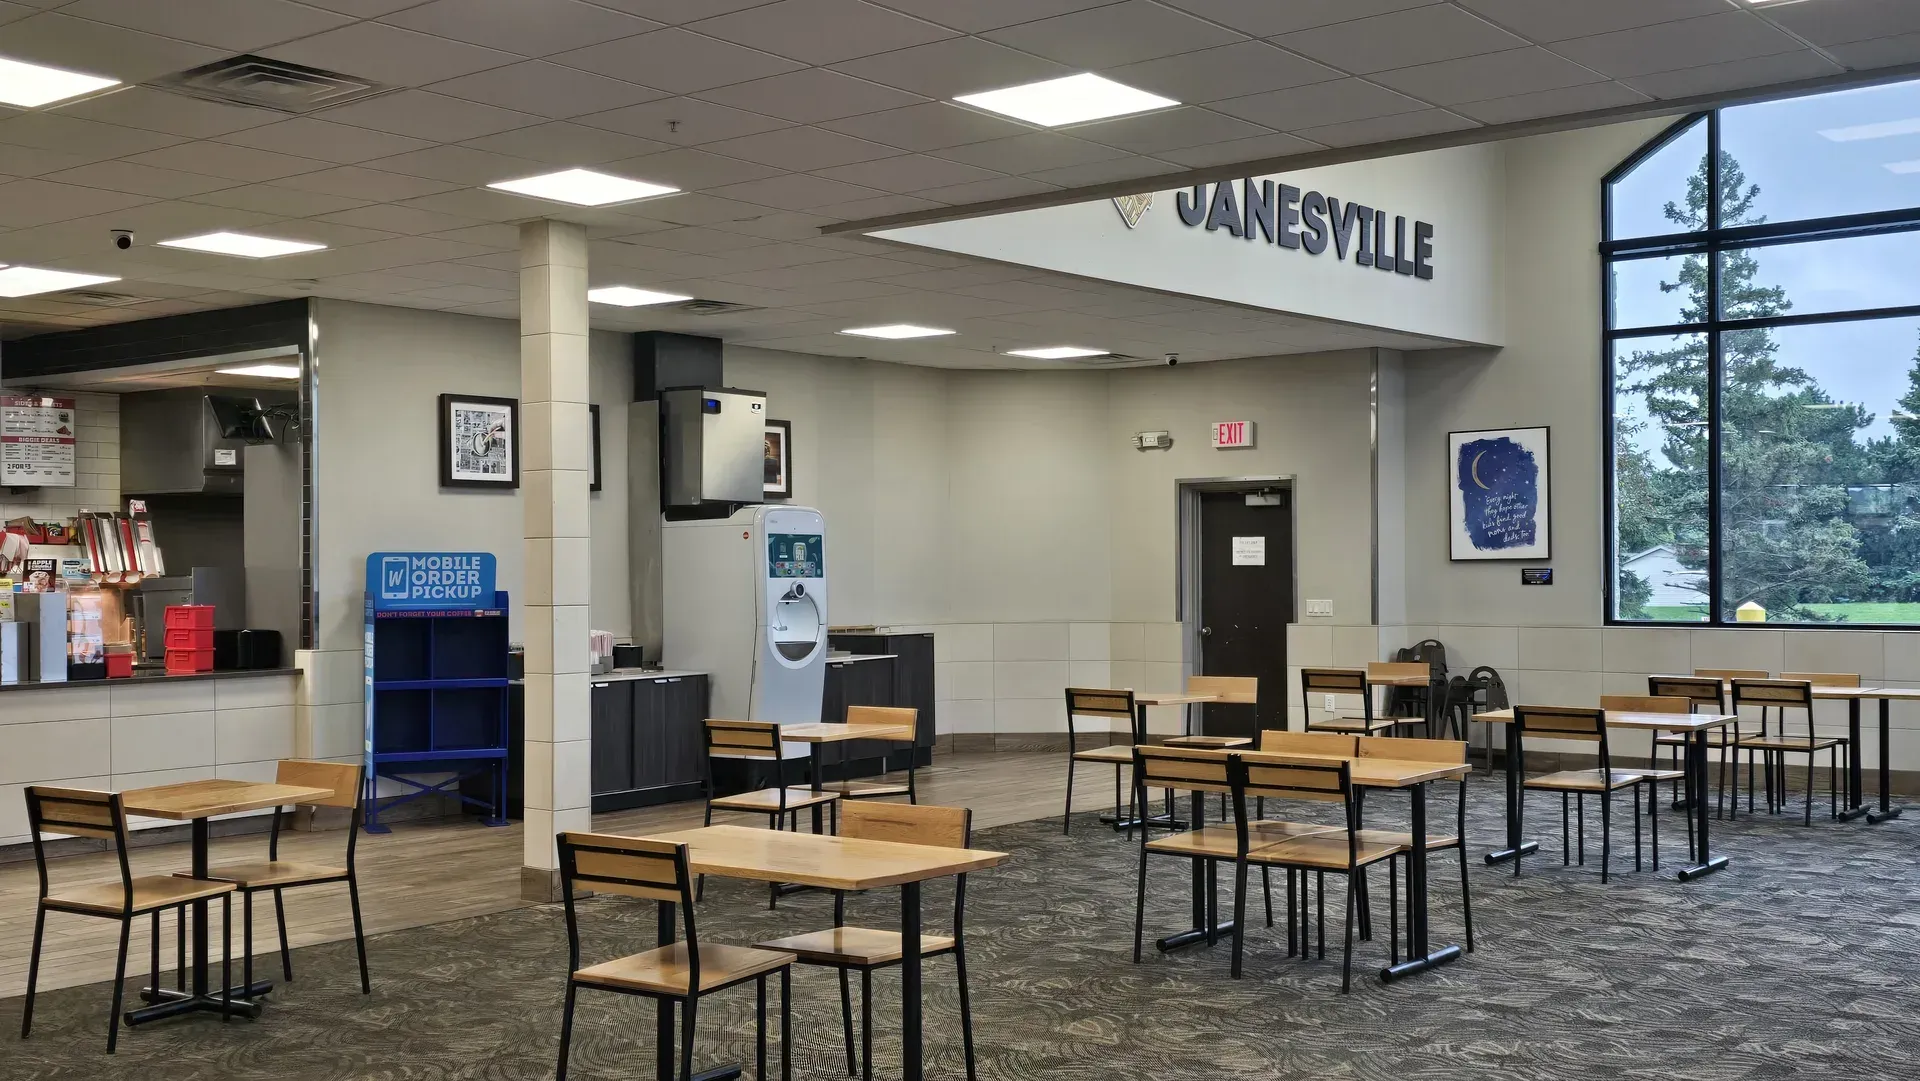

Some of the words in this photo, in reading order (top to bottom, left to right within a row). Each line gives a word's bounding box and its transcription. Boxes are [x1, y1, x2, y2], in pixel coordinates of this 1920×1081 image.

[1176, 177, 1434, 280] JANESVILLE
[1219, 422, 1244, 445] EXIT
[1512, 511, 1526, 524] good
[412, 556, 481, 570] MOBILE
[411, 571, 480, 585] ORDER
[412, 586, 482, 599] PICKUP
